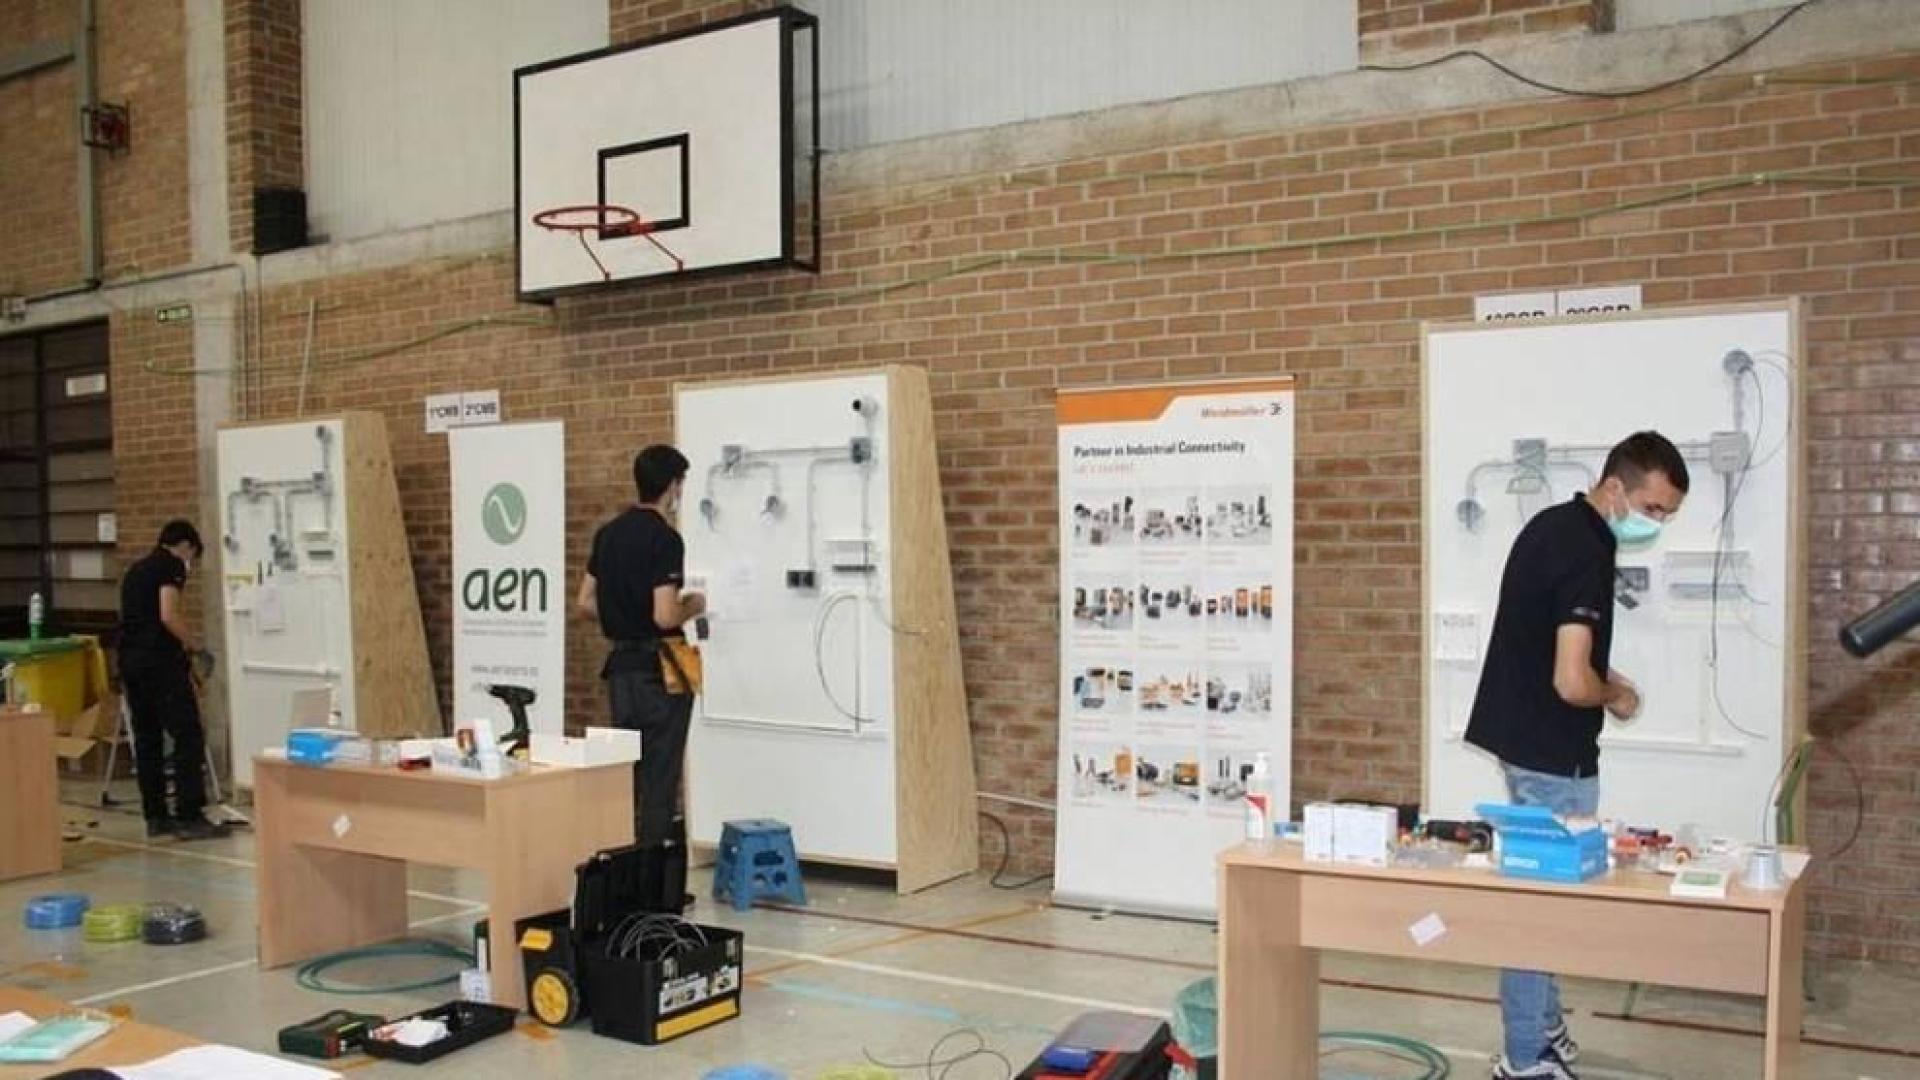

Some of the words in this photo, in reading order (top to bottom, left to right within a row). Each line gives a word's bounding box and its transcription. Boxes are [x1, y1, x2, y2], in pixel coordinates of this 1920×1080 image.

[1073, 446, 1112, 457] Partner
[1115, 447, 1124, 456] in
[1126, 443, 1176, 456] Industrial
[1179, 439, 1246, 454] Connectivity
[463, 568, 547, 612] aen
